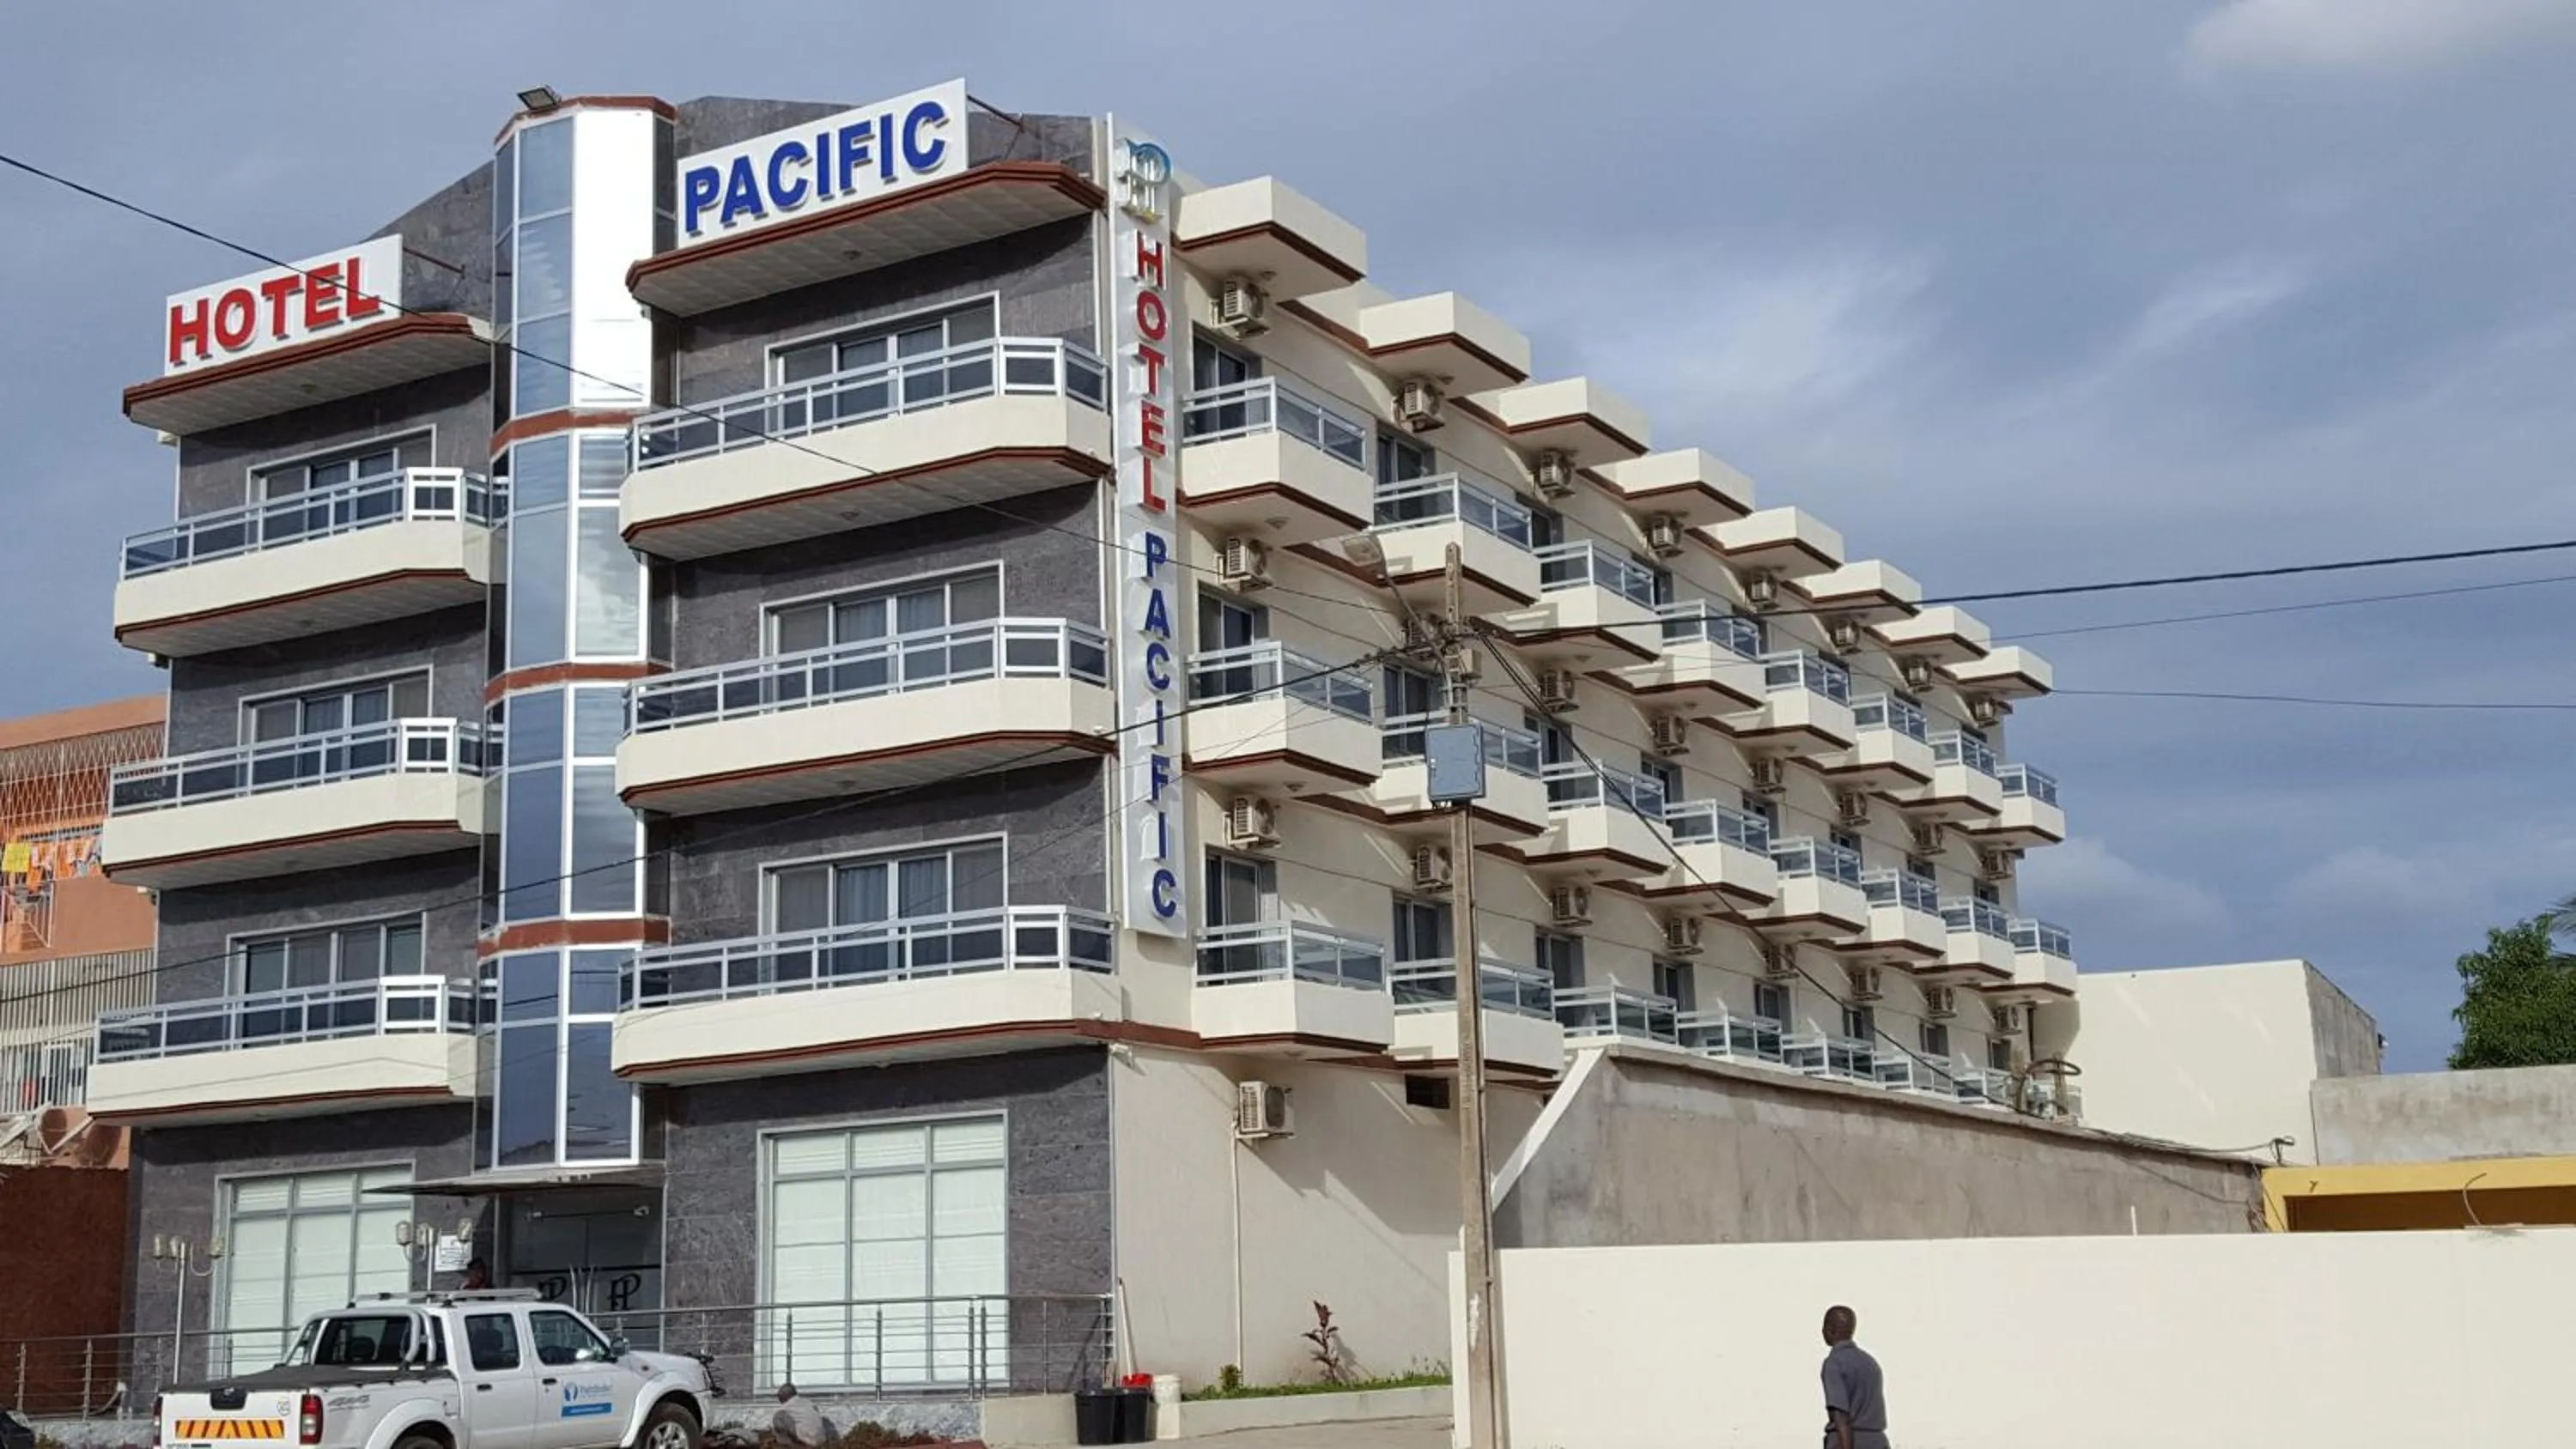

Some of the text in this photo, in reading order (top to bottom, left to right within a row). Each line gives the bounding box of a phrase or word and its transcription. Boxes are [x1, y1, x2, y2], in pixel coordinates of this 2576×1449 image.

[685, 100, 946, 233] PACIFIC
[168, 257, 381, 364] HOTEL
[1135, 230, 1169, 513] HOTEL
[1143, 531, 1177, 919] PACIFIC
